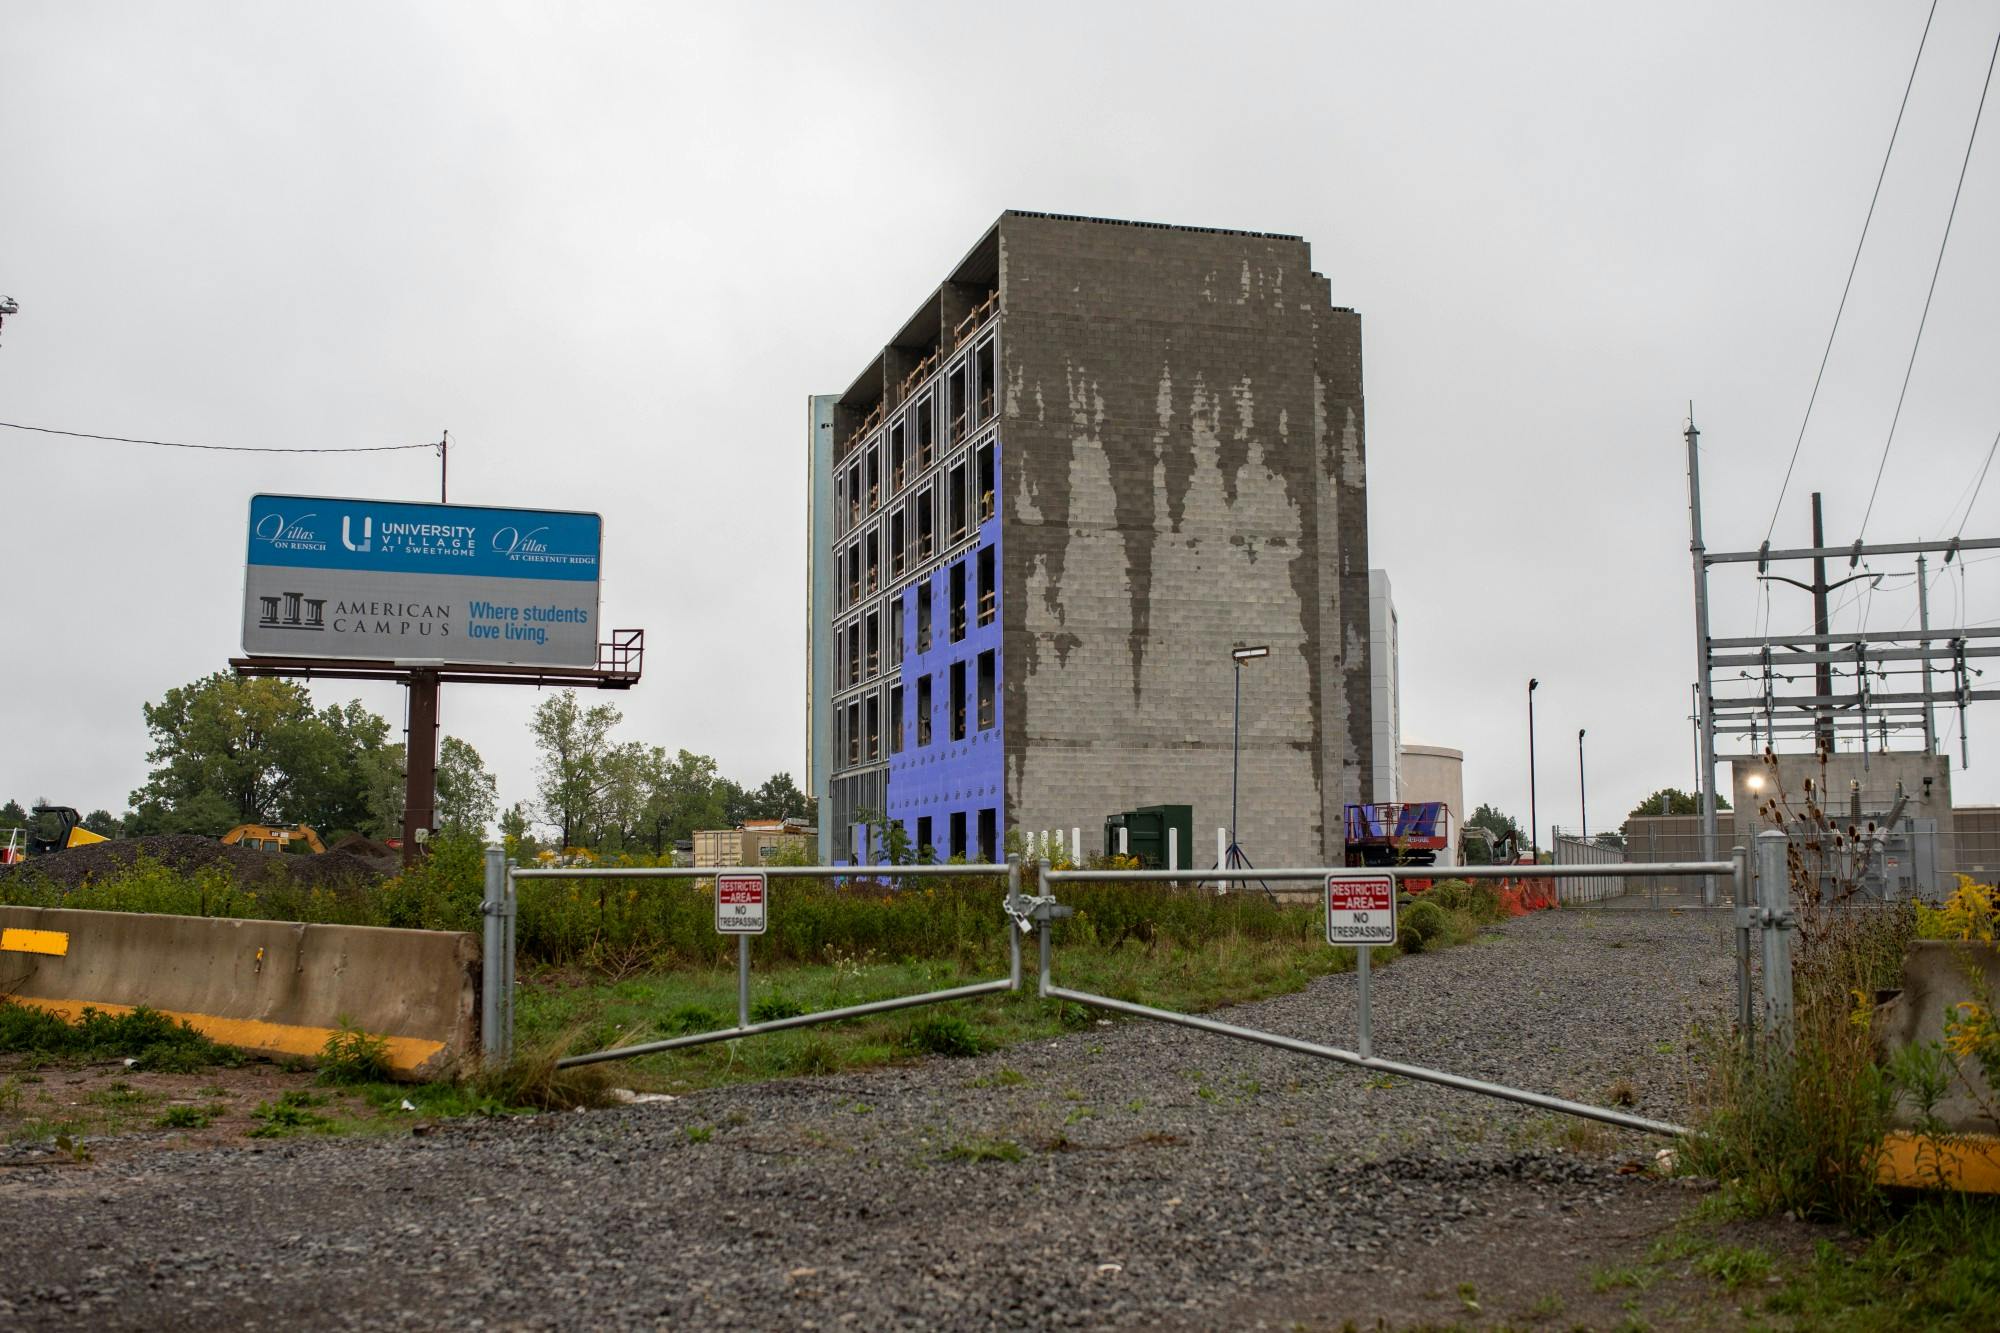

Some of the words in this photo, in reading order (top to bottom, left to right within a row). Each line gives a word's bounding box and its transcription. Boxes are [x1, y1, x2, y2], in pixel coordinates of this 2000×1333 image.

[256, 513, 317, 543] Villas
[382, 523, 476, 538] UNIVERSITY
[274, 542, 288, 550] ON
[291, 543, 326, 551] RENSCH
[382, 535, 475, 548] VILLAGE
[492, 527, 549, 556] Villas
[406, 546, 475, 557] SWEETHOME
[522, 554, 567, 564] CHESTNUT
[335, 600, 450, 618] AMERICAN
[469, 601, 519, 620] Where
[523, 605, 588, 624] students
[333, 618, 450, 636] CAMPUS
[468, 620, 500, 639] love
[505, 622, 549, 645] living.
[720, 881, 762, 892] RESTRICTED
[1332, 884, 1389, 896] RESTRICTED
[730, 892, 752, 903] AREA
[1346, 896, 1375, 909] AREA
[735, 905, 747, 915] NO
[720, 917, 762, 927] TRESPASSING
[1353, 912, 1369, 923] NO
[1332, 926, 1391, 938] TRESPASSING
